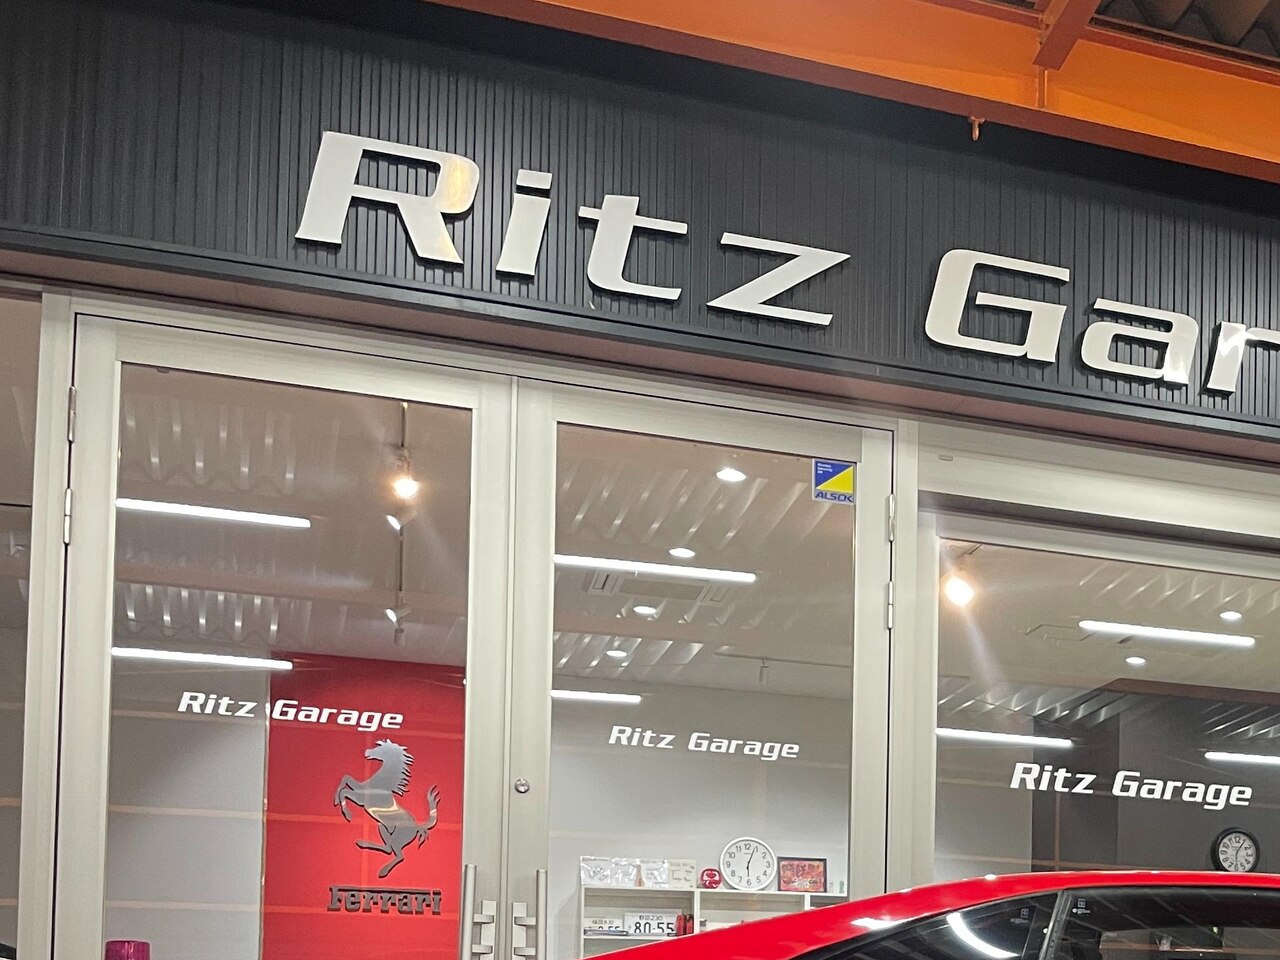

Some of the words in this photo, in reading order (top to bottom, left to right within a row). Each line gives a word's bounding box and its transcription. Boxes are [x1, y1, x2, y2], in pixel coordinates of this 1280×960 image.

[295, 131, 851, 326] Ritz
[815, 491, 854, 503] ALSOK
[177, 691, 258, 718] Ritz
[271, 699, 404, 732] Garage
[608, 724, 675, 750] Ritz
[687, 732, 800, 761] Garage
[1009, 762, 1096, 794] Ritz
[1111, 769, 1254, 810] Garage
[728, 851, 736, 859] 10
[736, 845, 742, 853] 11
[726, 861, 732, 869] 9
[766, 861, 771, 869] 3
[731, 870, 736, 878] 8
[763, 870, 768, 878] 4
[327, 886, 442, 915] Ferrari
[634, 921, 675, 934] 80-55
